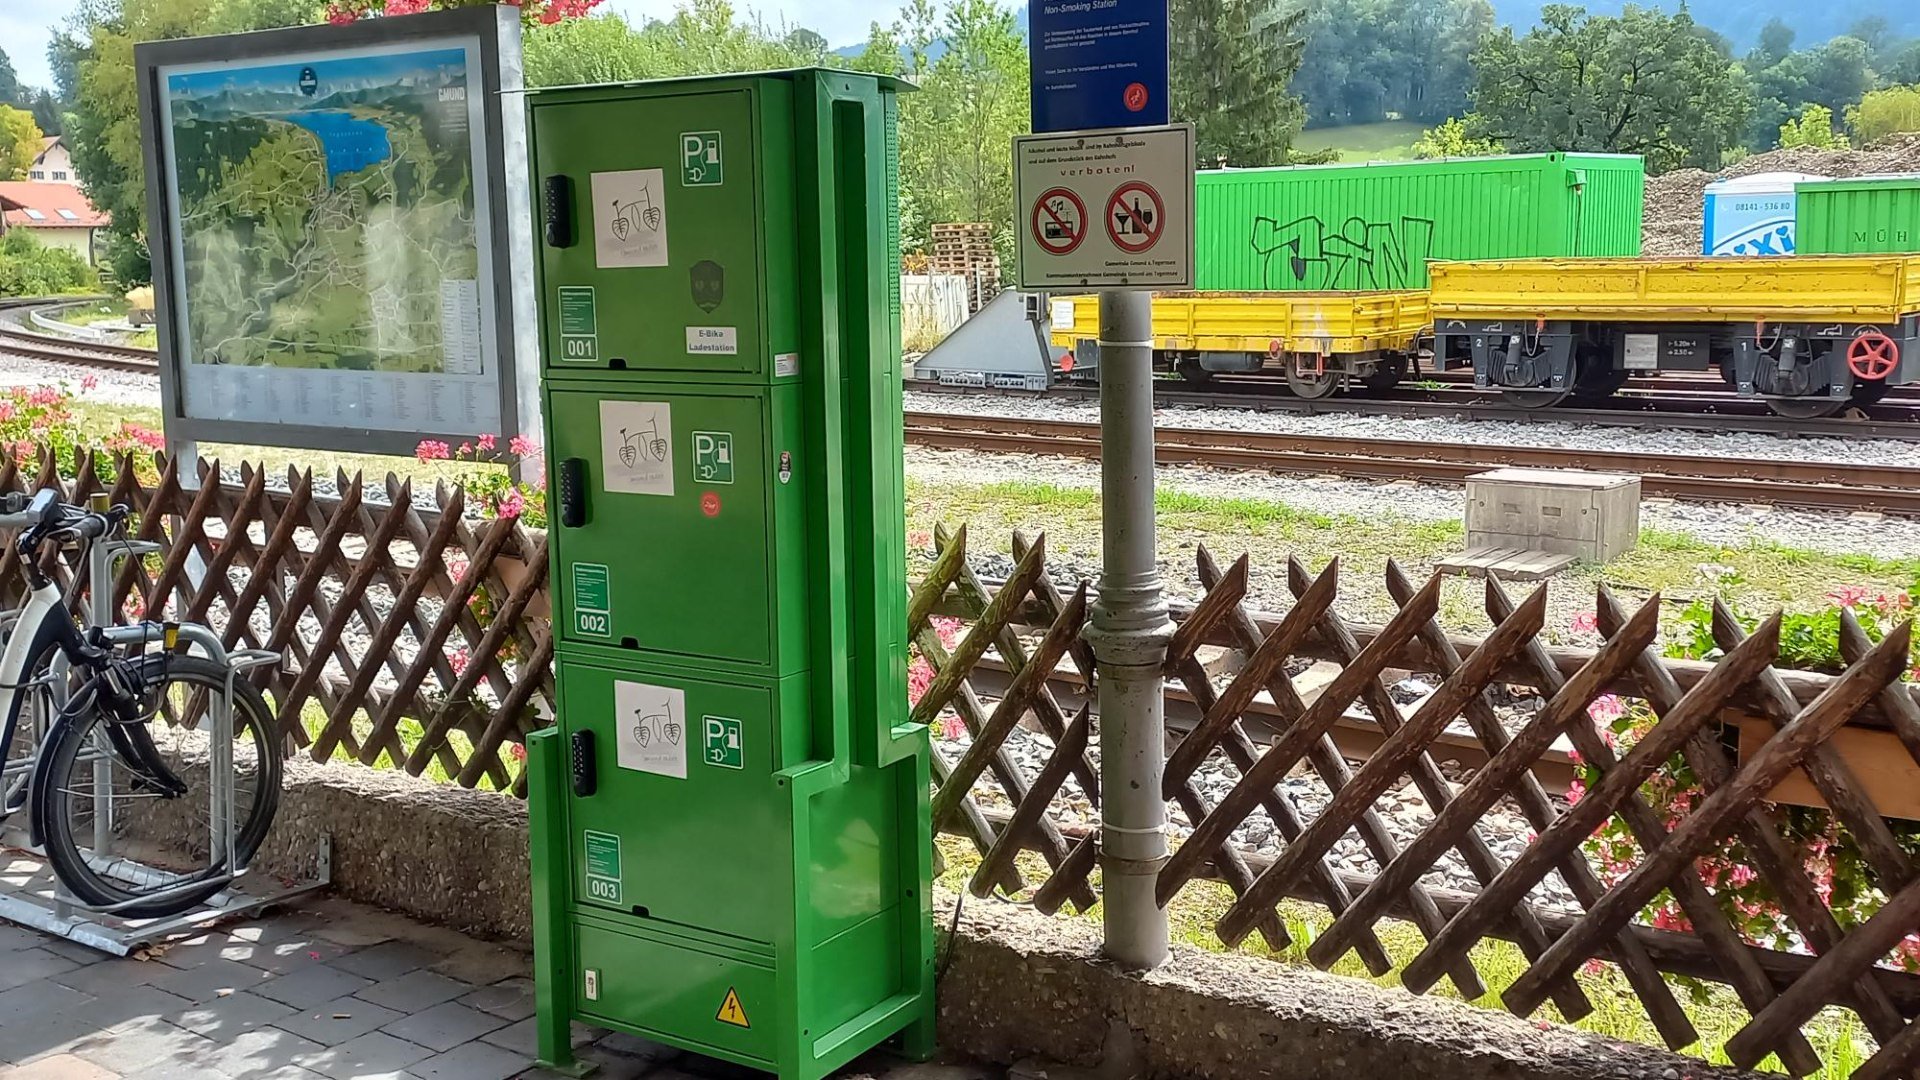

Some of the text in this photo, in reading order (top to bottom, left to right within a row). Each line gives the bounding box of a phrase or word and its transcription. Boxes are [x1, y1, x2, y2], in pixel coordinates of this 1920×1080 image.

[1044, 0, 1118, 15] Non-Smoking Station
[438, 87, 465, 102] GMUND
[684, 136, 703, 168] P
[699, 329, 724, 338] E-Bike
[567, 340, 592, 357] 001
[688, 343, 735, 352] Ladestation
[1476, 338, 1483, 348] 2
[695, 435, 714, 465] P
[580, 614, 606, 633] 002
[705, 719, 725, 748] P
[591, 880, 617, 899] 003
